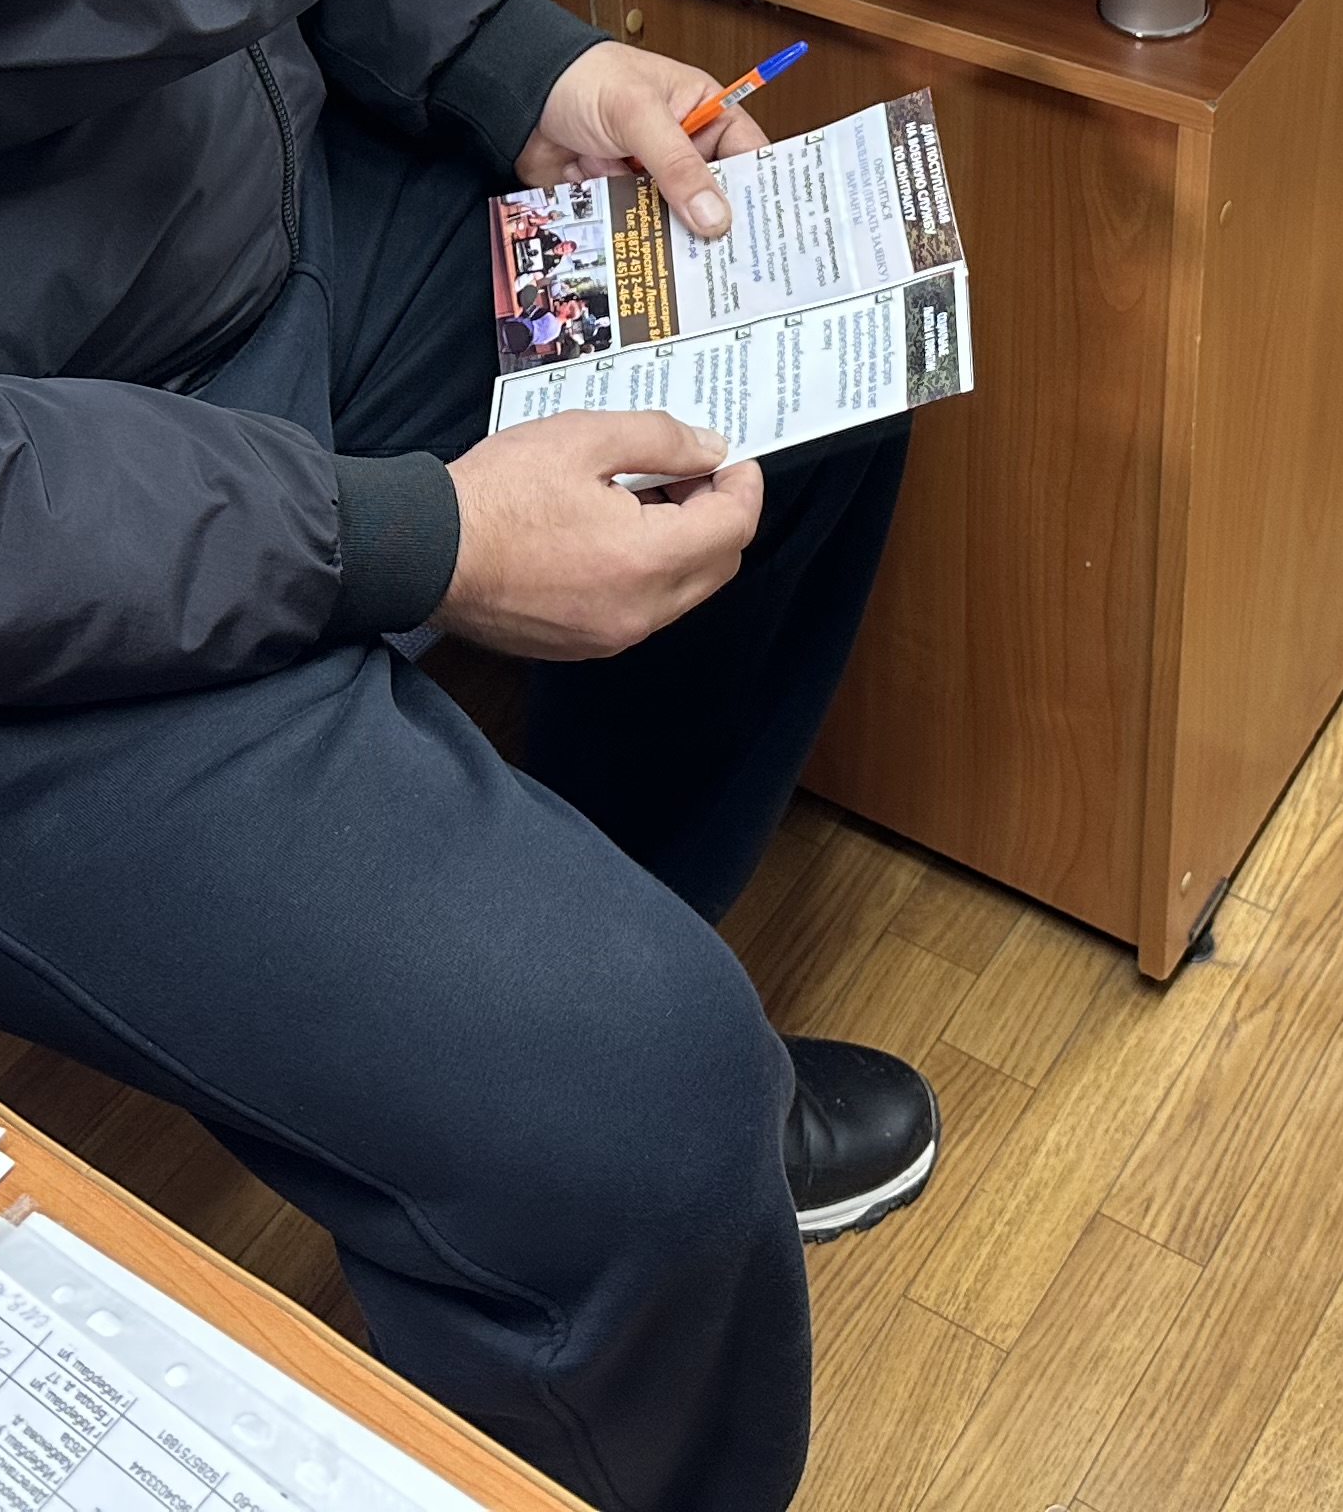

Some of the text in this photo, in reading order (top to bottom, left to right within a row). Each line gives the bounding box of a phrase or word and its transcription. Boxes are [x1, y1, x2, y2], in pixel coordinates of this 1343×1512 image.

[874, 158, 893, 220] ОБРАТИТЬСЯ
[892, 146, 918, 223] ПО КОНТРАКТУ
[904, 121, 936, 234] НА ВОЕННУЮ СЛУЖБУ
[920, 124, 950, 225] ДЛЯ ПОСТУПЛЕНИЯ
[635, 185, 655, 240] Избербаш,
[863, 190, 879, 233] (ПОДАТЬ
[871, 234, 889, 282] ЗАЯВКУ)
[639, 240, 658, 287] проспект
[628, 276, 644, 314] 2-40-62
[642, 287, 661, 328] Ленина
[45, 1372, 60, 1384] 17
[38, 1388, 101, 1435] Избербаш,
[60, 1432, 87, 1458] 263а
